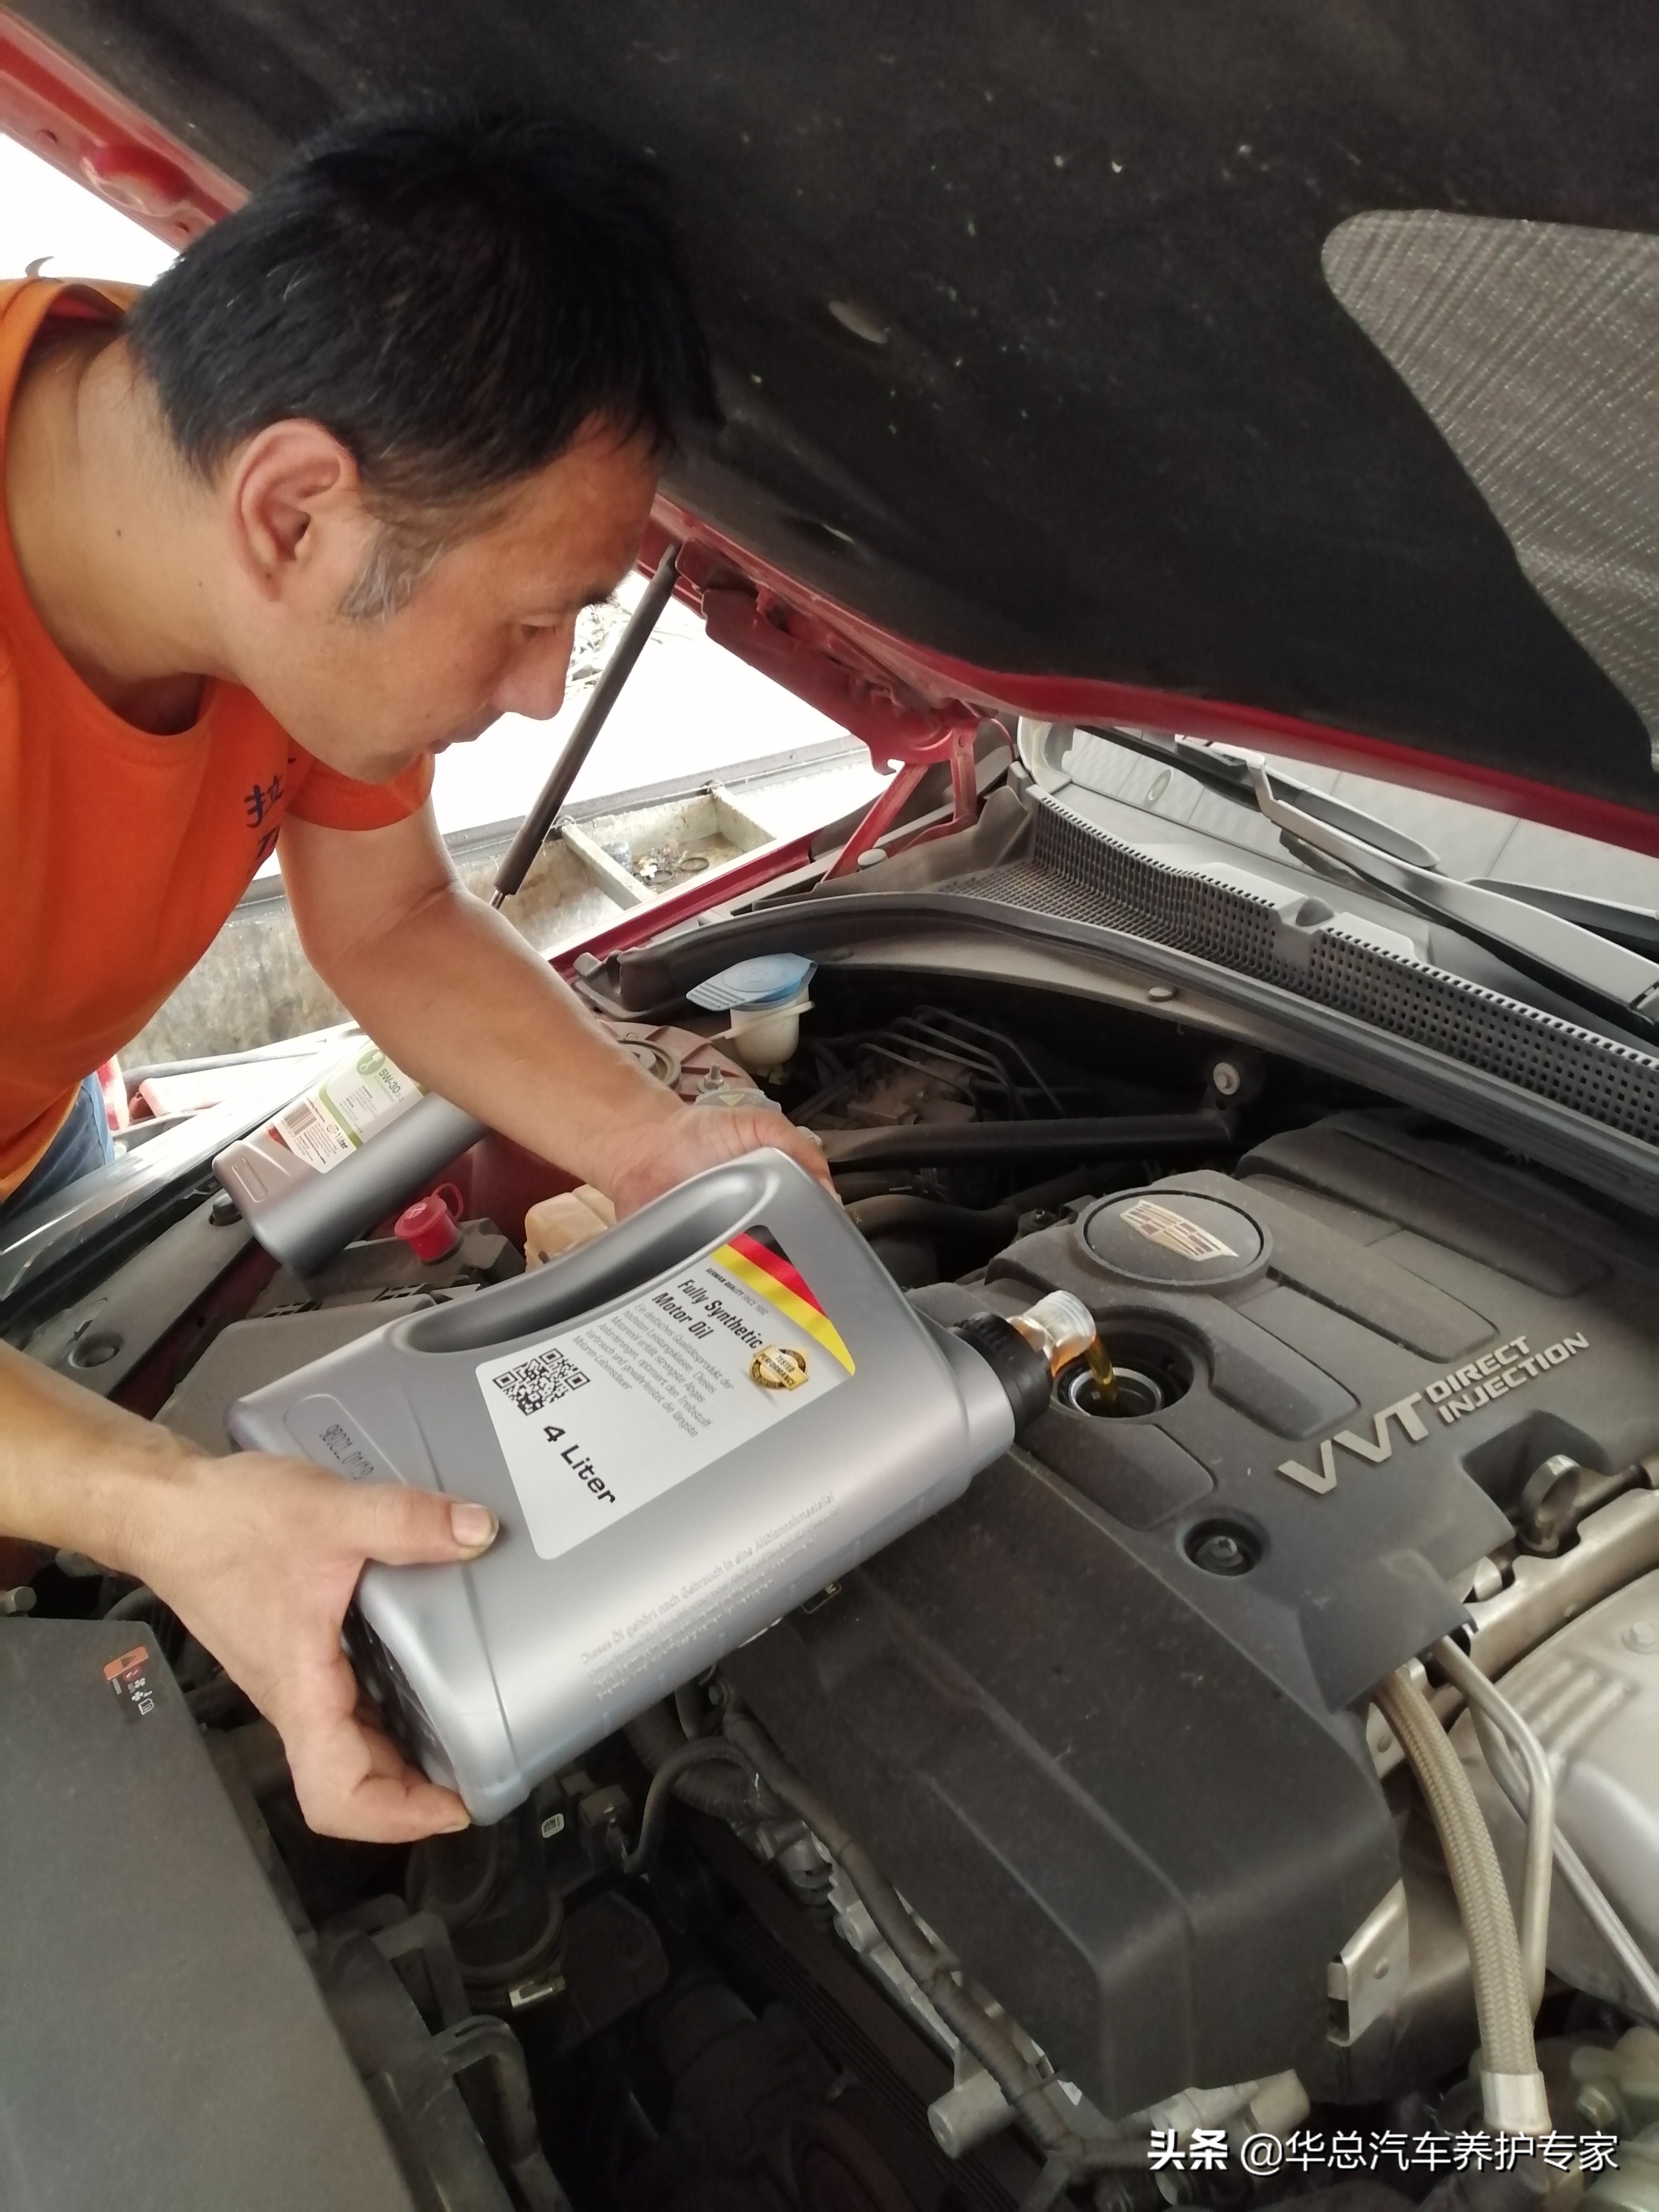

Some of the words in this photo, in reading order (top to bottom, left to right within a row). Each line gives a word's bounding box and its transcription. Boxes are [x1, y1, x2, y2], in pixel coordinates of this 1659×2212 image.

[379, 1068, 401, 1095] 5W-30
[336, 1135, 349, 1150] Liter
[706, 1268, 726, 1283] GERMAN
[724, 1281, 744, 1297] QUALITY
[651, 1292, 693, 1323] Motor
[688, 1321, 714, 1340] Oil
[677, 1279, 709, 1305] Fully
[704, 1300, 764, 1350] Synthetic
[644, 1311, 675, 1337] deutsches
[720, 1378, 734, 1390] der
[655, 1355, 686, 1384] strengste
[758, 1352, 796, 1386] PERFORMANCE
[774, 1354, 795, 1373] TESTED
[1425, 1335, 1531, 1403] DIRECT
[612, 1353, 628, 1365] und
[661, 1401, 675, 1413] die
[638, 1358, 668, 1386] optimiert
[665, 1384, 680, 1397] den
[692, 1370, 716, 1394] Dieses
[1437, 1331, 1590, 1425] INJECTION
[543, 1425, 566, 1444] 4
[560, 1444, 616, 1504] Liter
[1277, 1391, 1430, 1495] VVT
